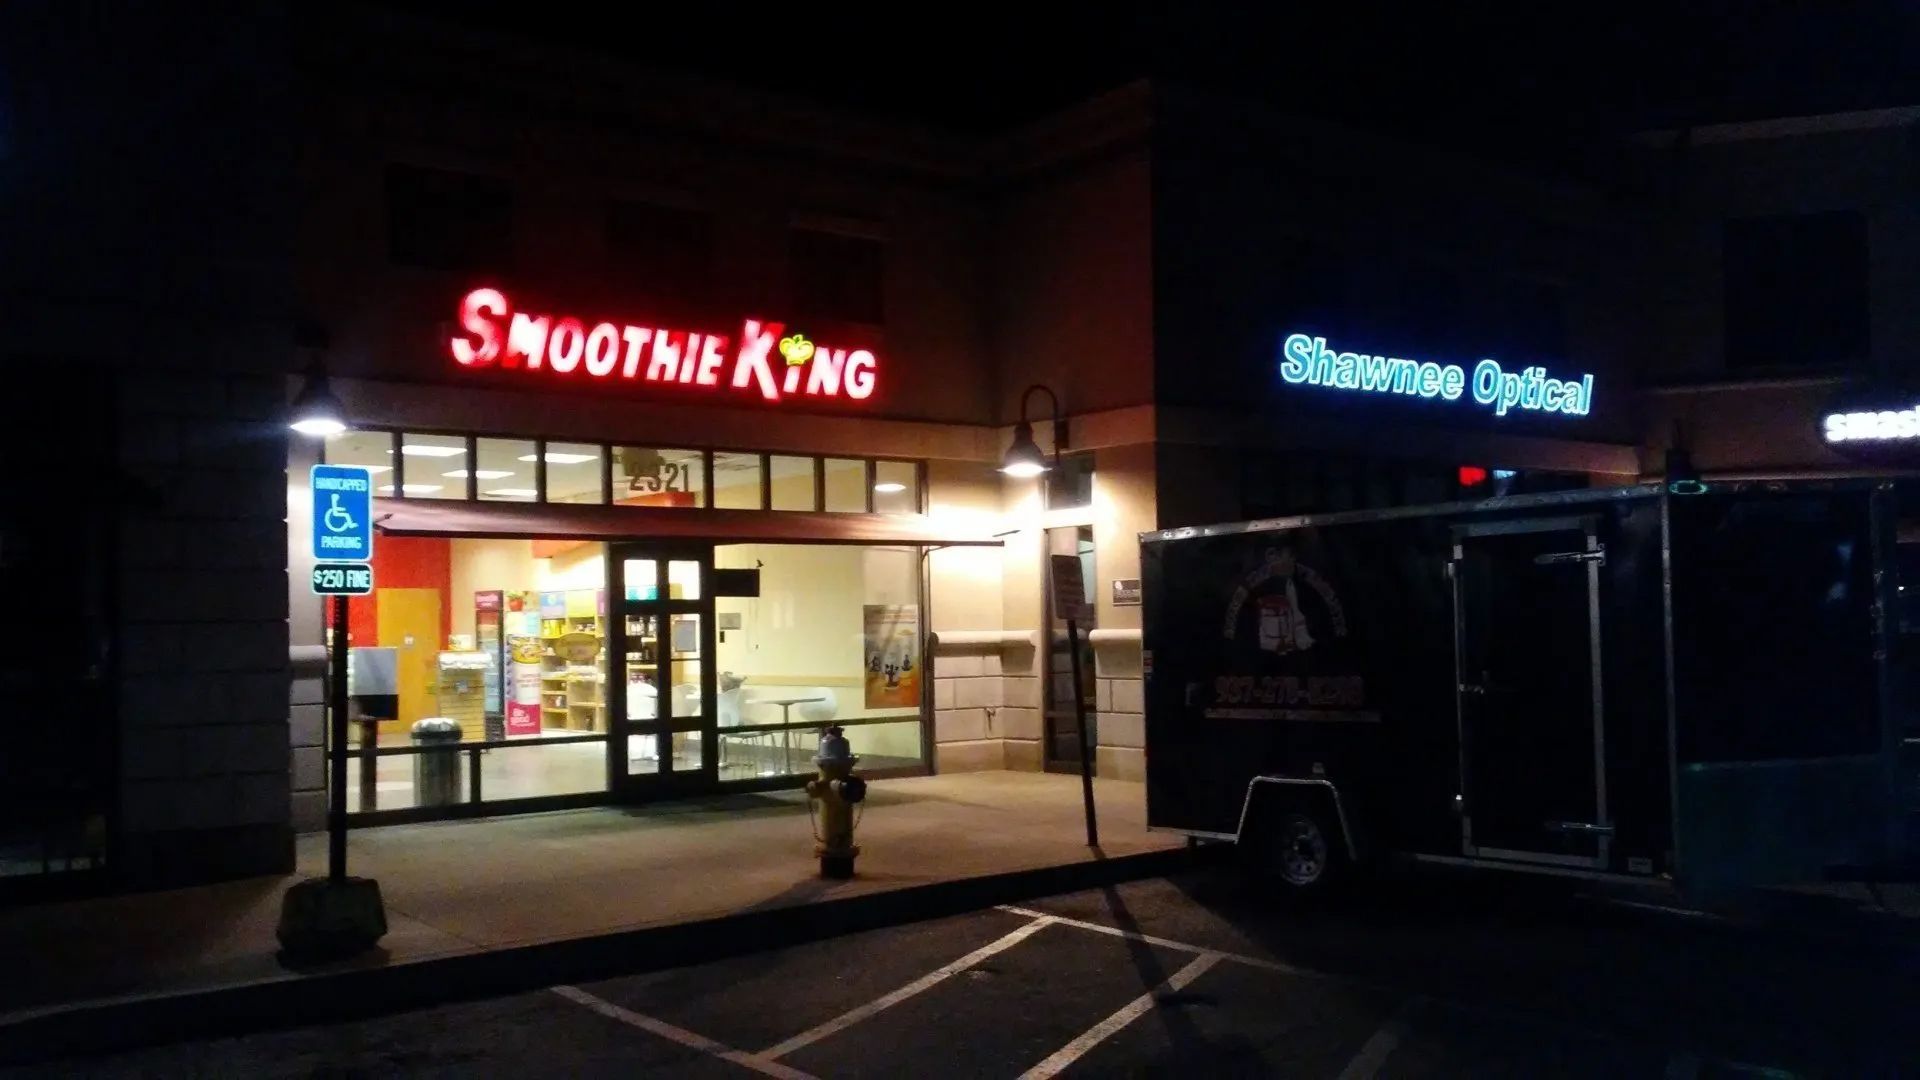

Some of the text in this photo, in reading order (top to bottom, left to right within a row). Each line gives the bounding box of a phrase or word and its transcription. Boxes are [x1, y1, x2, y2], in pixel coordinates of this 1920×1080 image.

[452, 288, 876, 400] SMOOTHIE KING
[1281, 334, 1594, 416] Shawnee Optical
[1825, 405, 1920, 441] smas
[315, 477, 368, 492] HANDICAPPED
[321, 535, 362, 549] PARKING
[313, 569, 370, 588] $250 FINE
